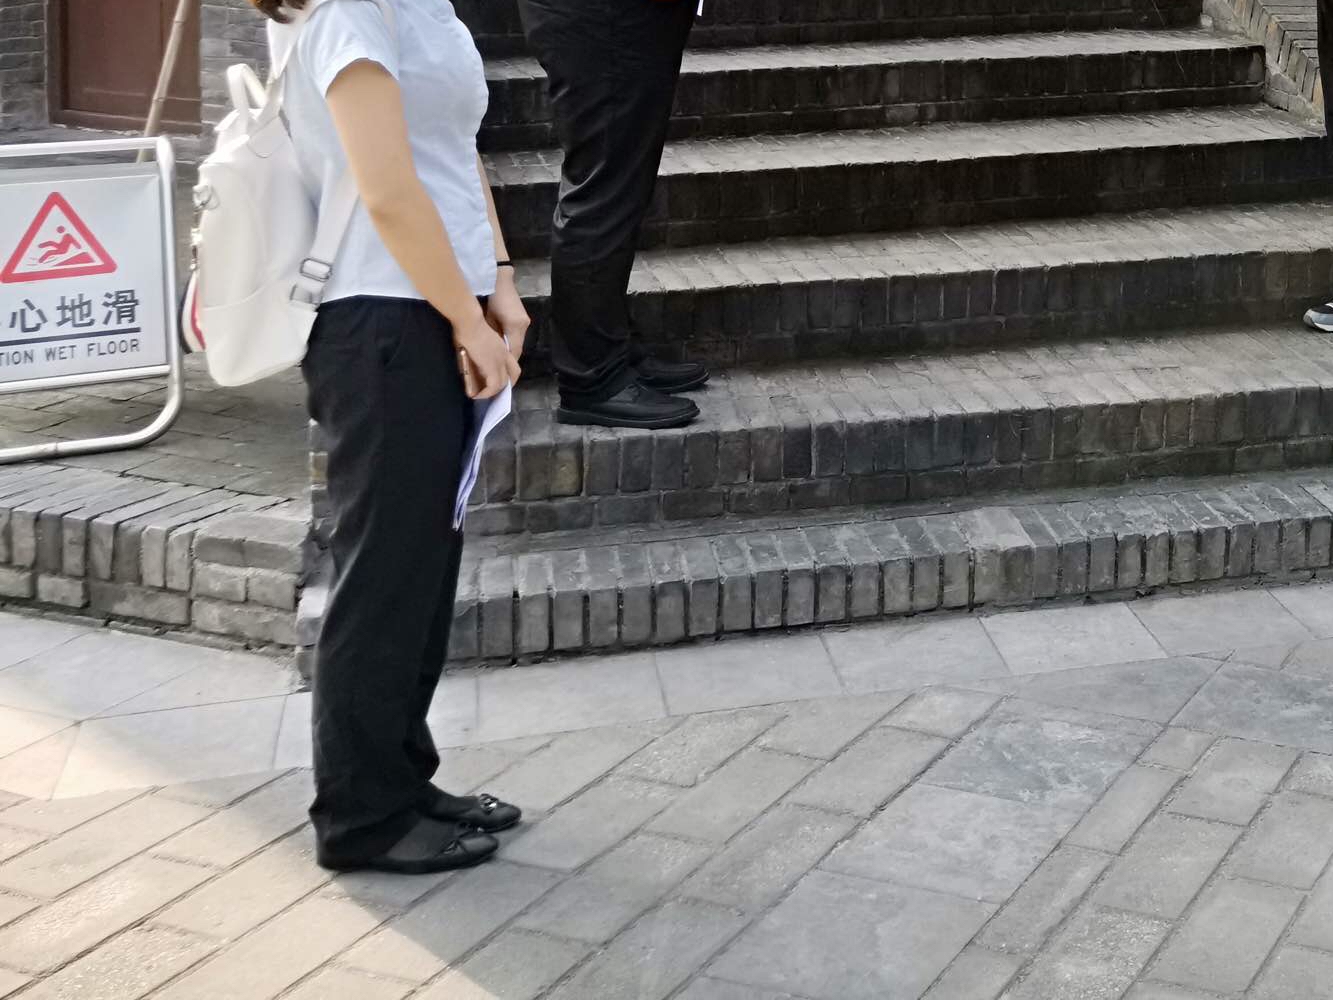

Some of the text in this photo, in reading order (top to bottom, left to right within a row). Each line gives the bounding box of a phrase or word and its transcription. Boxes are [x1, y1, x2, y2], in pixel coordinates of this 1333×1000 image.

[0, 289, 140, 333] 心地滑
[45, 344, 77, 361] WET
[87, 338, 140, 357] FLOOR
